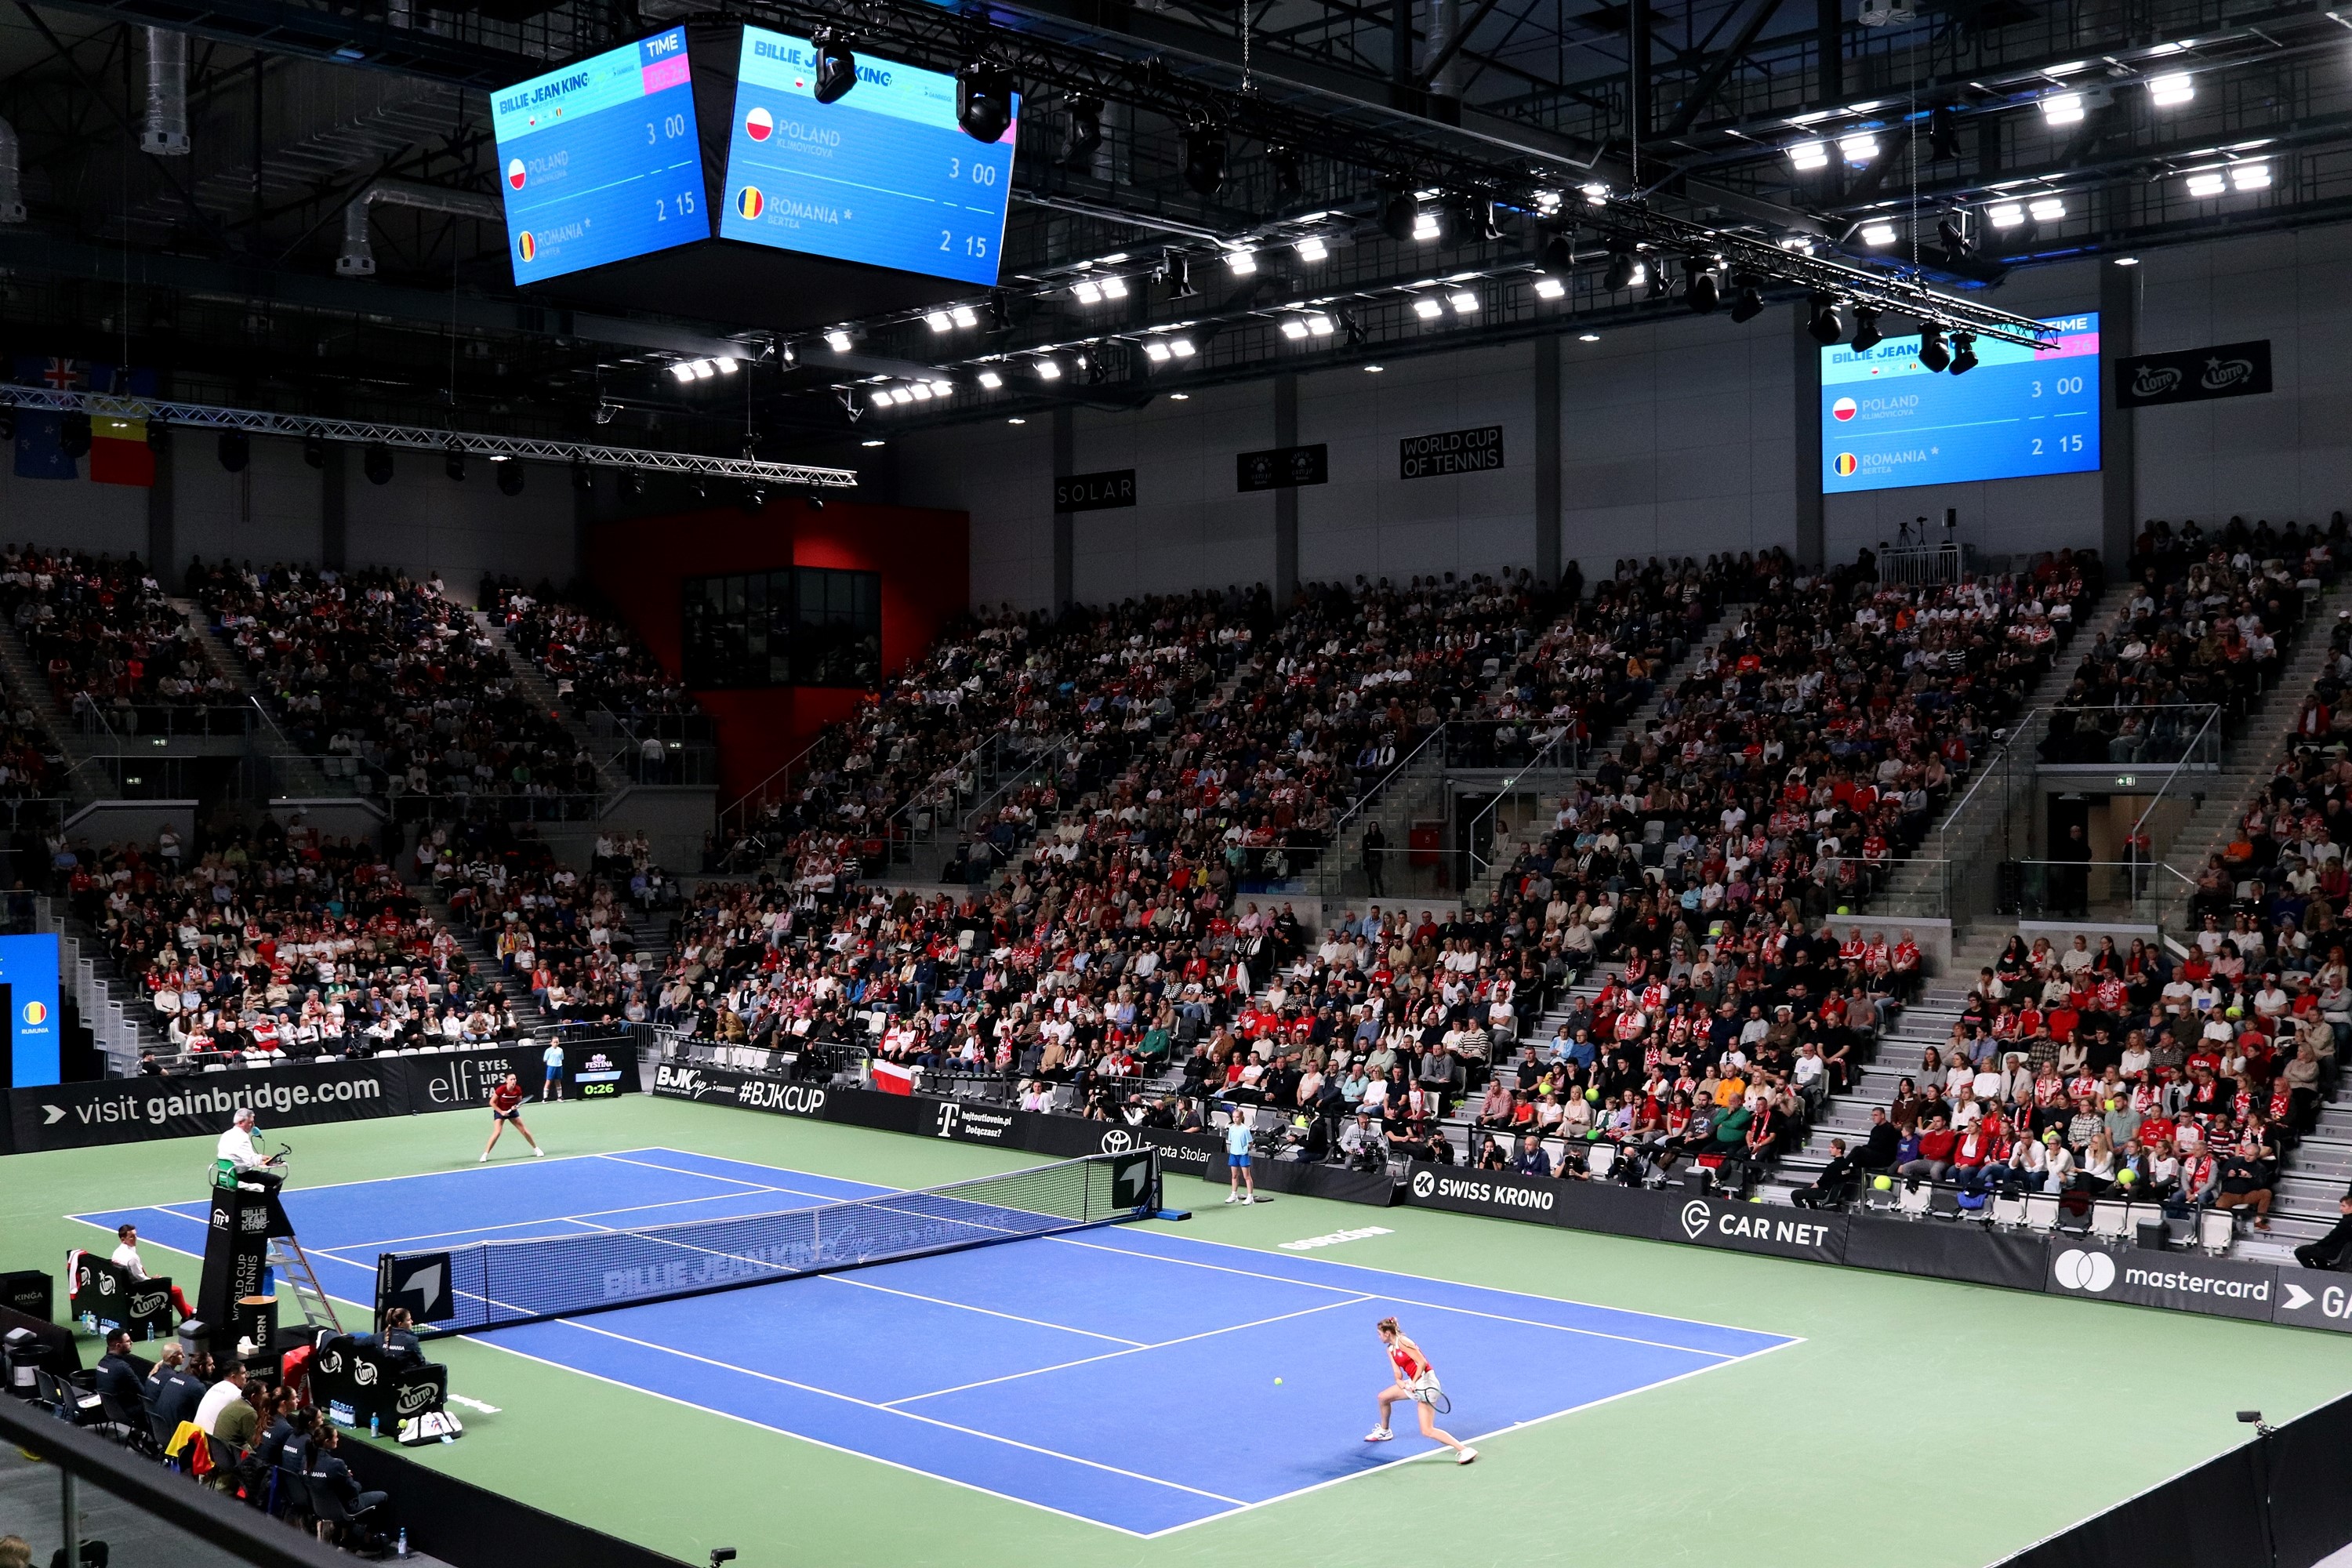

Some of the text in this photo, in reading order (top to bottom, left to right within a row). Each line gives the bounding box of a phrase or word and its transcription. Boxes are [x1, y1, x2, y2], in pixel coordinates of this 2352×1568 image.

[646, 33, 679, 57] TIME
[754, 40, 801, 65] BILLIE
[855, 65, 891, 88] KING
[499, 71, 590, 115] BILLIE JEAN KING
[528, 114, 684, 176] POLAND 3 00
[779, 119, 996, 187] POLAND 3 00
[537, 191, 695, 249] ROMANIA 2 15
[768, 215, 800, 230] BERTEA
[770, 196, 986, 258] ROMANIA 2 15
[1832, 343, 1918, 365] BILLIE JEAN
[2141, 372, 2172, 391] LOTTO
[2210, 364, 2243, 384] LOTTO
[1862, 376, 2083, 412] POLAND 3 00
[1861, 408, 1914, 421] KLIMOVICOVA
[1404, 429, 1498, 456] WORLD CUP
[1863, 434, 2083, 467] ROMANIA 2 15
[1403, 449, 1498, 477] OF TENNIS
[1862, 465, 1892, 475] BERTEA
[1058, 479, 1131, 504] SOLAR
[478, 1059, 512, 1073] EYES.
[584, 1083, 615, 1095] 0:26
[656, 1065, 695, 1091] BJK
[76, 1078, 380, 1125] visit gainbridge.com
[739, 1080, 825, 1113] #BJKCUP
[961, 1111, 1012, 1127] hejtoutlovein.pl
[965, 1124, 1002, 1138] Dołączasz?
[1179, 1146, 1212, 1163] Stolar
[1438, 1178, 1554, 1210] SWISS KRONO
[213, 1214, 226, 1226] ITF
[241, 1208, 267, 1218] BILLIE
[1719, 1214, 1829, 1247] CAR NET
[237, 1254, 247, 1277] CUP
[603, 1261, 686, 1298] BILLIE
[2125, 1267, 2269, 1301] mastercard
[14, 1292, 43, 1301] KINGA
[136, 1295, 162, 1313] LOTTO
[358, 1368, 374, 1381] LOTTO
[405, 1387, 431, 1407] LOTTO
[303, 1469, 327, 1479] RMANIA
